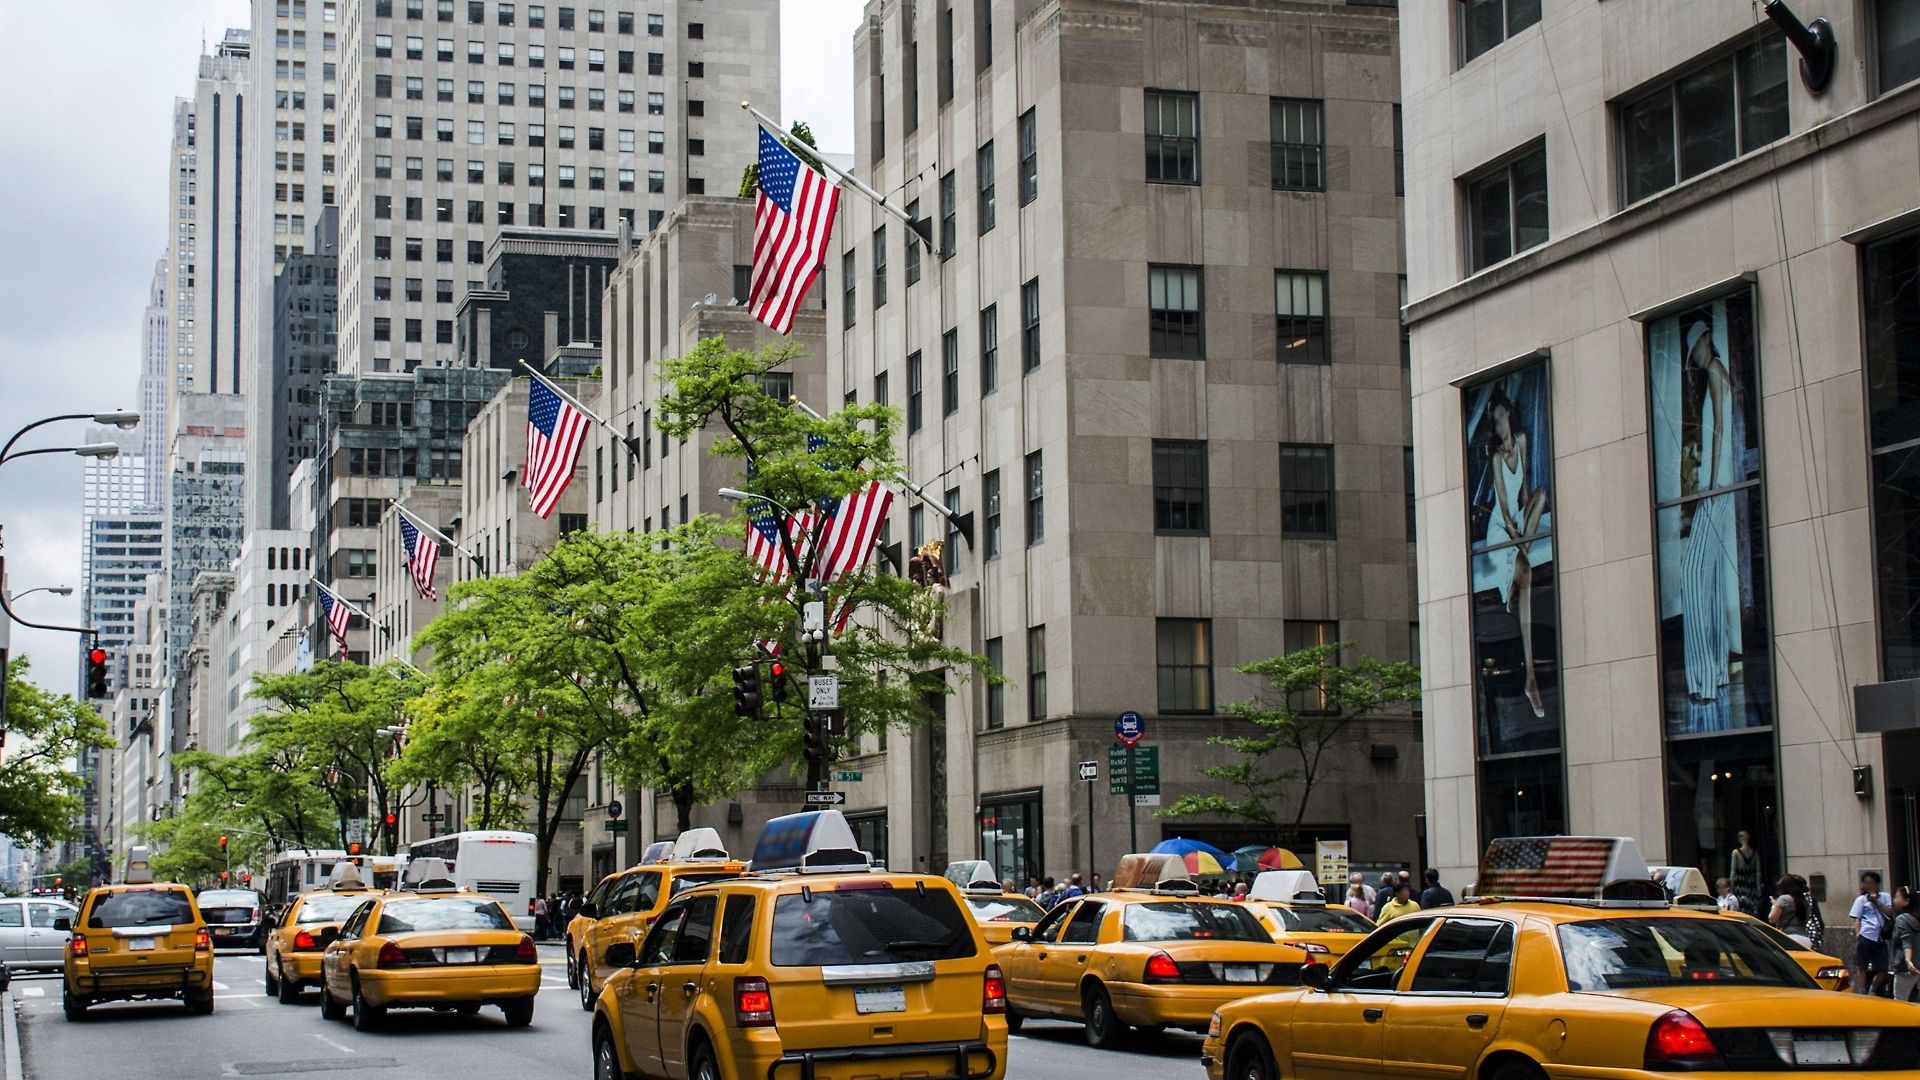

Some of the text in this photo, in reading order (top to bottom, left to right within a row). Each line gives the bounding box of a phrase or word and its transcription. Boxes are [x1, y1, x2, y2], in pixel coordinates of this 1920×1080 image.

[814, 678, 833, 686] BUSES
[846, 772, 854, 781] 51
[809, 794, 820, 802] ONE
